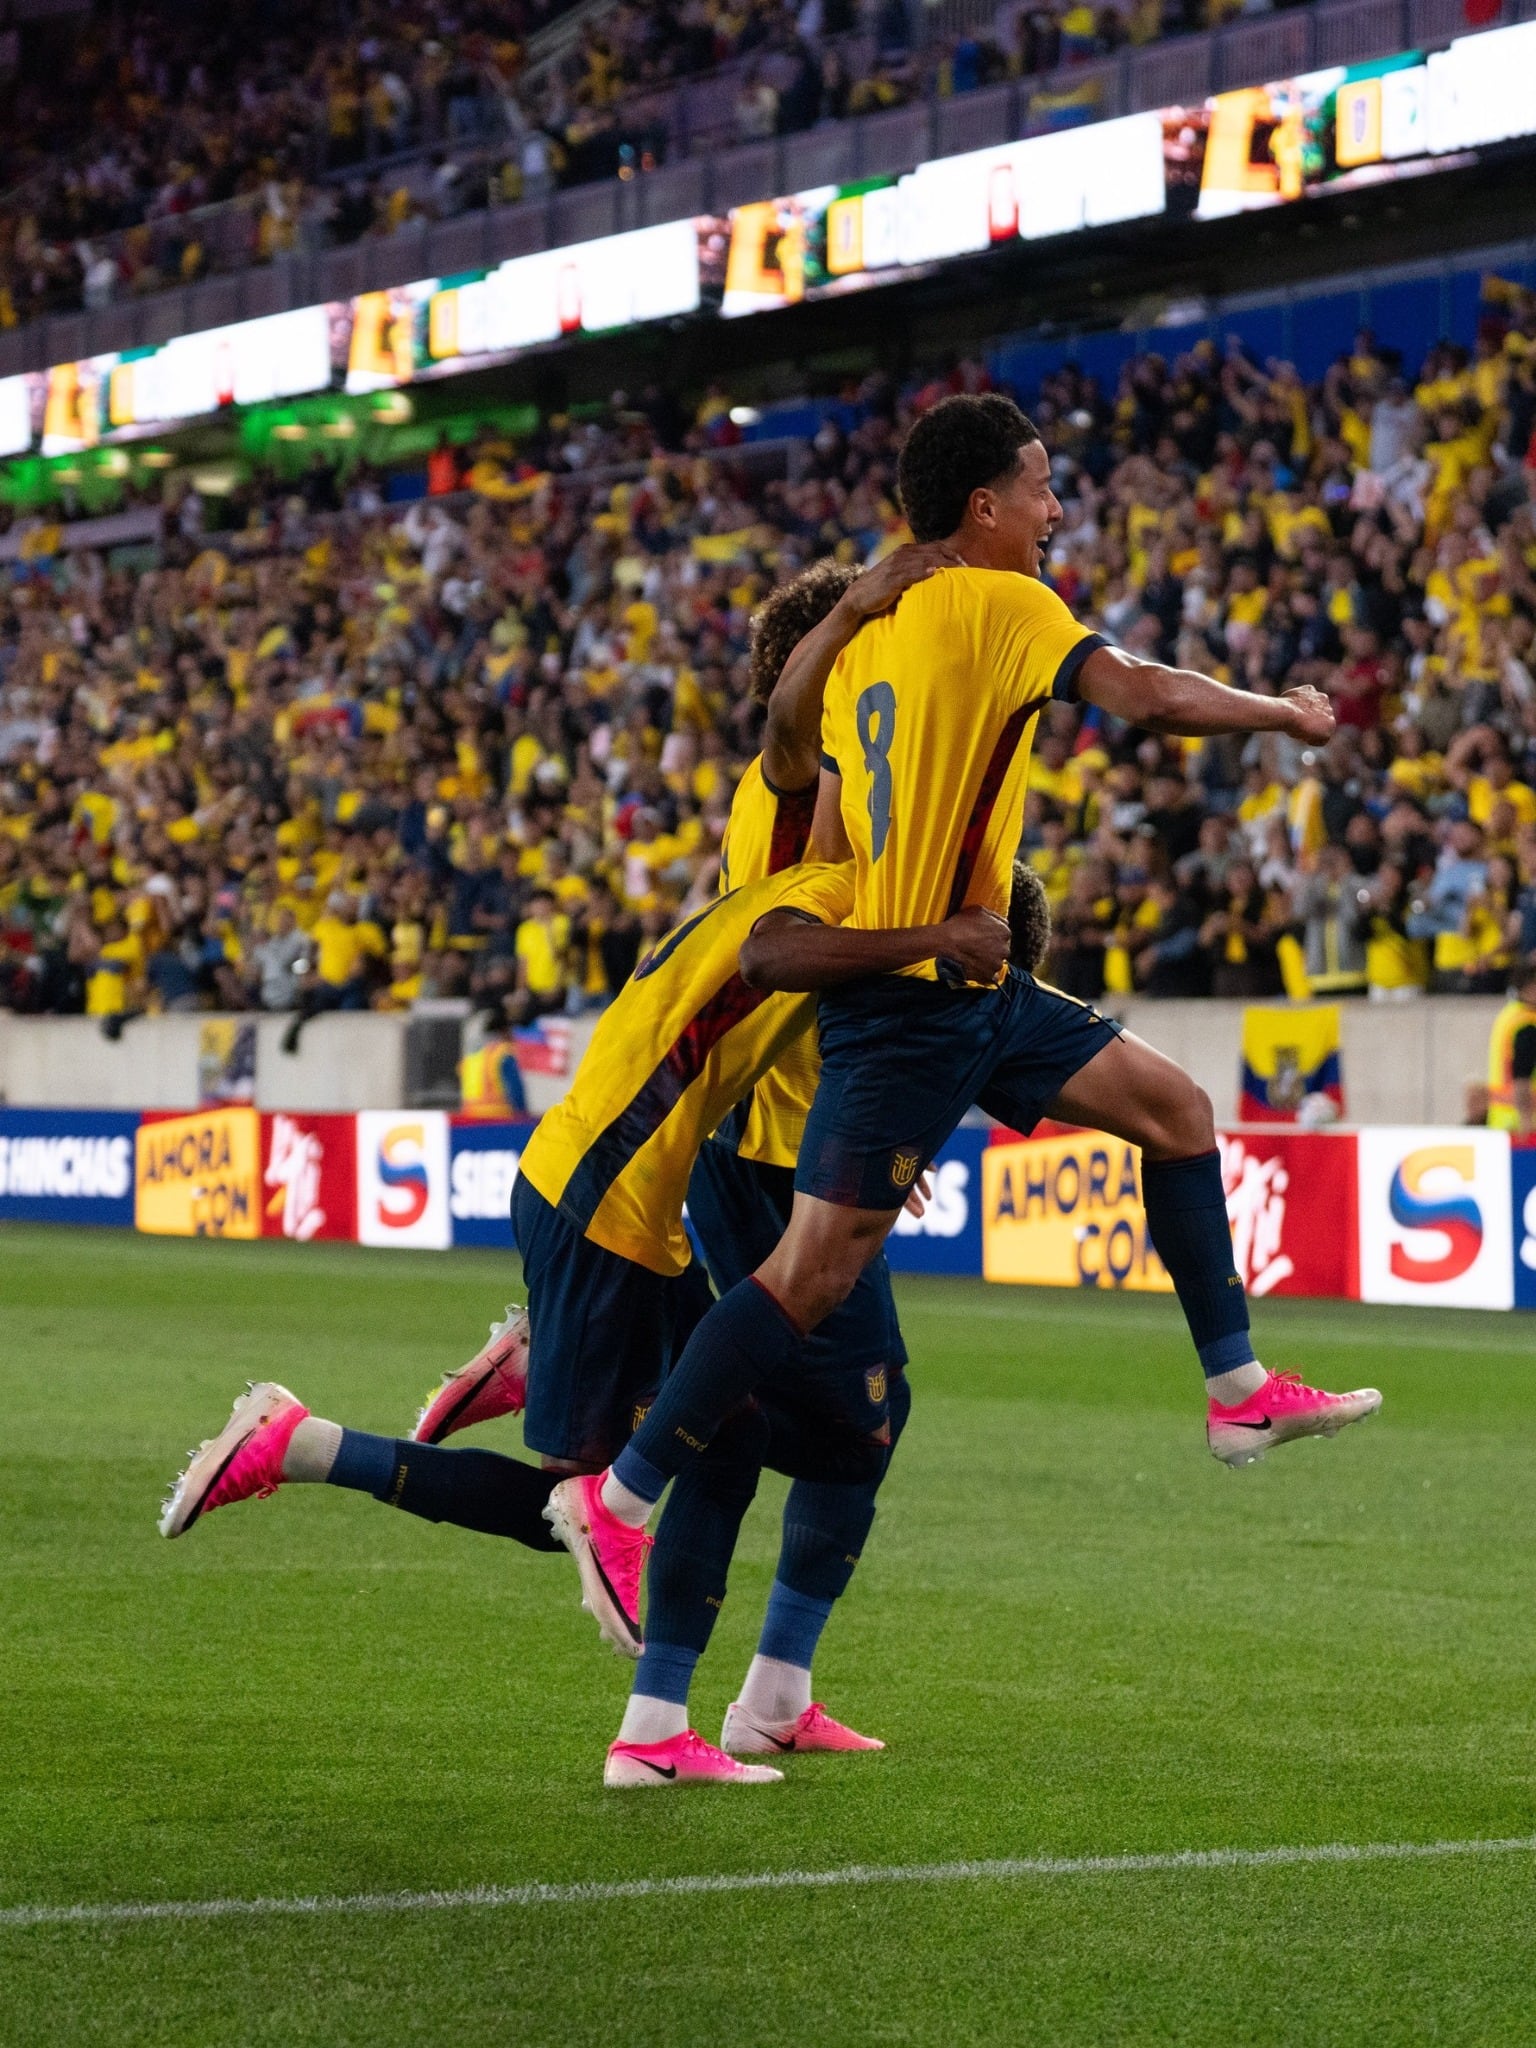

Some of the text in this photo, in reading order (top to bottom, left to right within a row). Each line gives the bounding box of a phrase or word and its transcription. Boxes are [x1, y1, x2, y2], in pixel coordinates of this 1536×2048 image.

[856, 681, 896, 864] 8
[9, 1136, 131, 1198] HINCHAS
[144, 1126, 231, 1184] AHORA
[377, 1123, 428, 1229] S
[994, 1148, 1139, 1223] AHORA
[192, 1183, 249, 1236] CON
[1389, 1145, 1483, 1284] S
